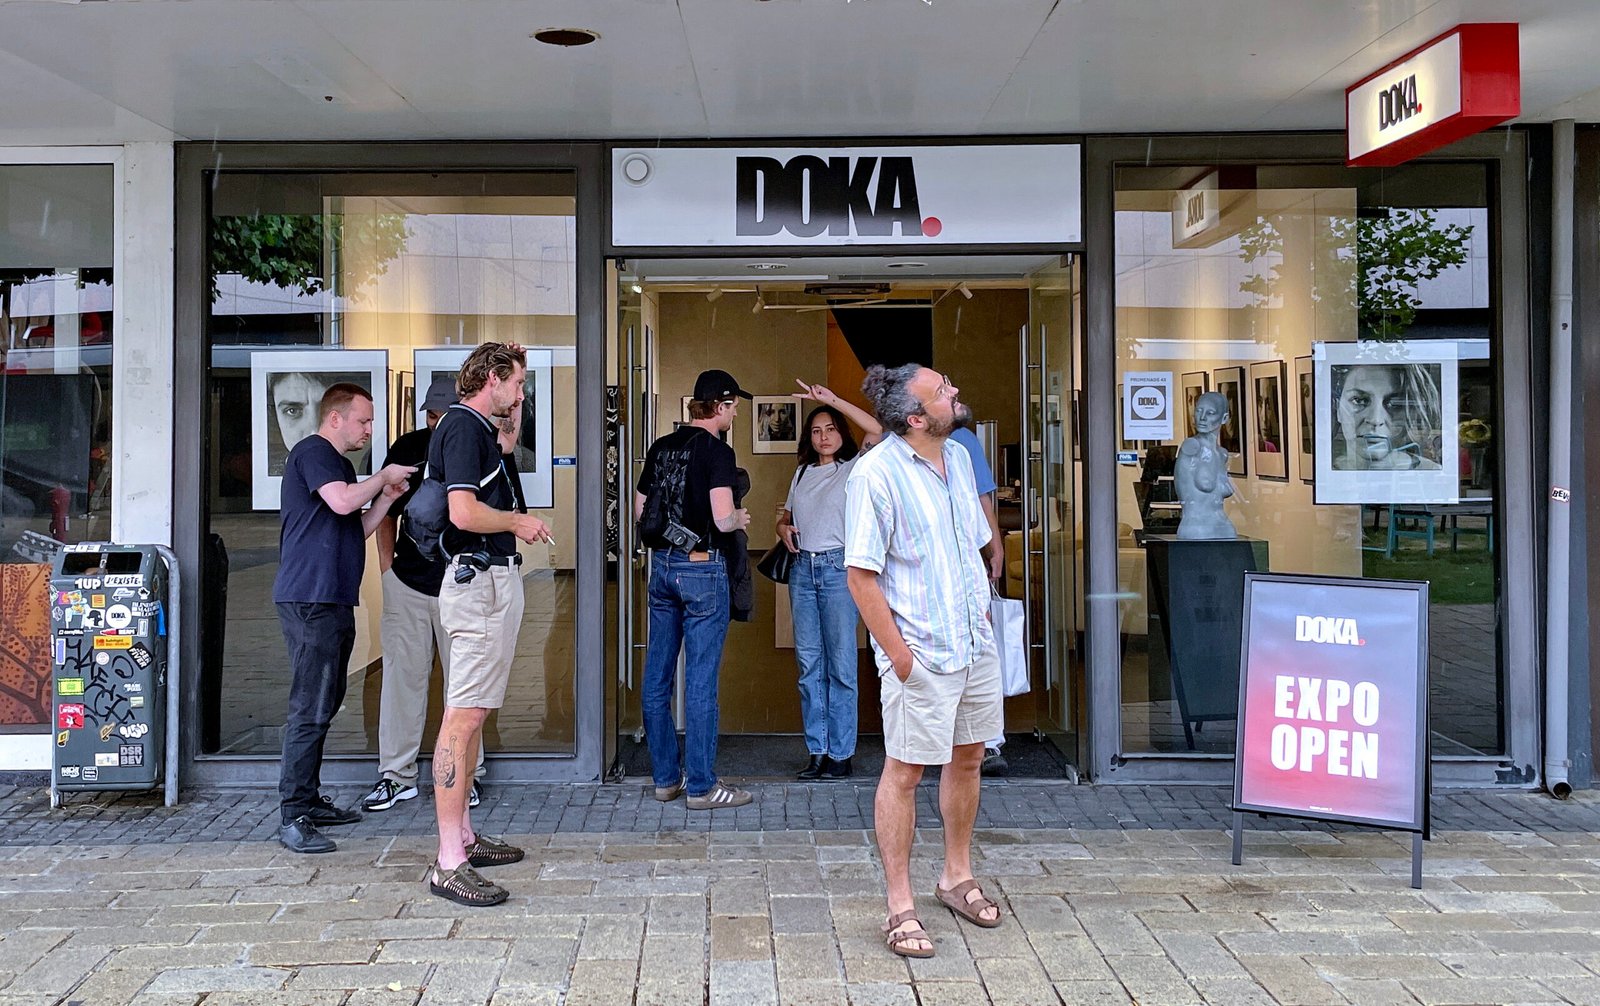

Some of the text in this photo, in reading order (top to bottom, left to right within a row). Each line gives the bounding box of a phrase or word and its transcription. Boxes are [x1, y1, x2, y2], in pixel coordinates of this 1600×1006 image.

[1379, 73, 1423, 132] DOKA.
[736, 155, 943, 237] DOKA.
[74, 578, 101, 589] 1UP
[1295, 615, 1366, 647] DOKA.
[1275, 675, 1380, 727] EXPO
[120, 746, 143, 755] DSR
[120, 755, 143, 765] BEV
[1270, 725, 1379, 780] OPEN
